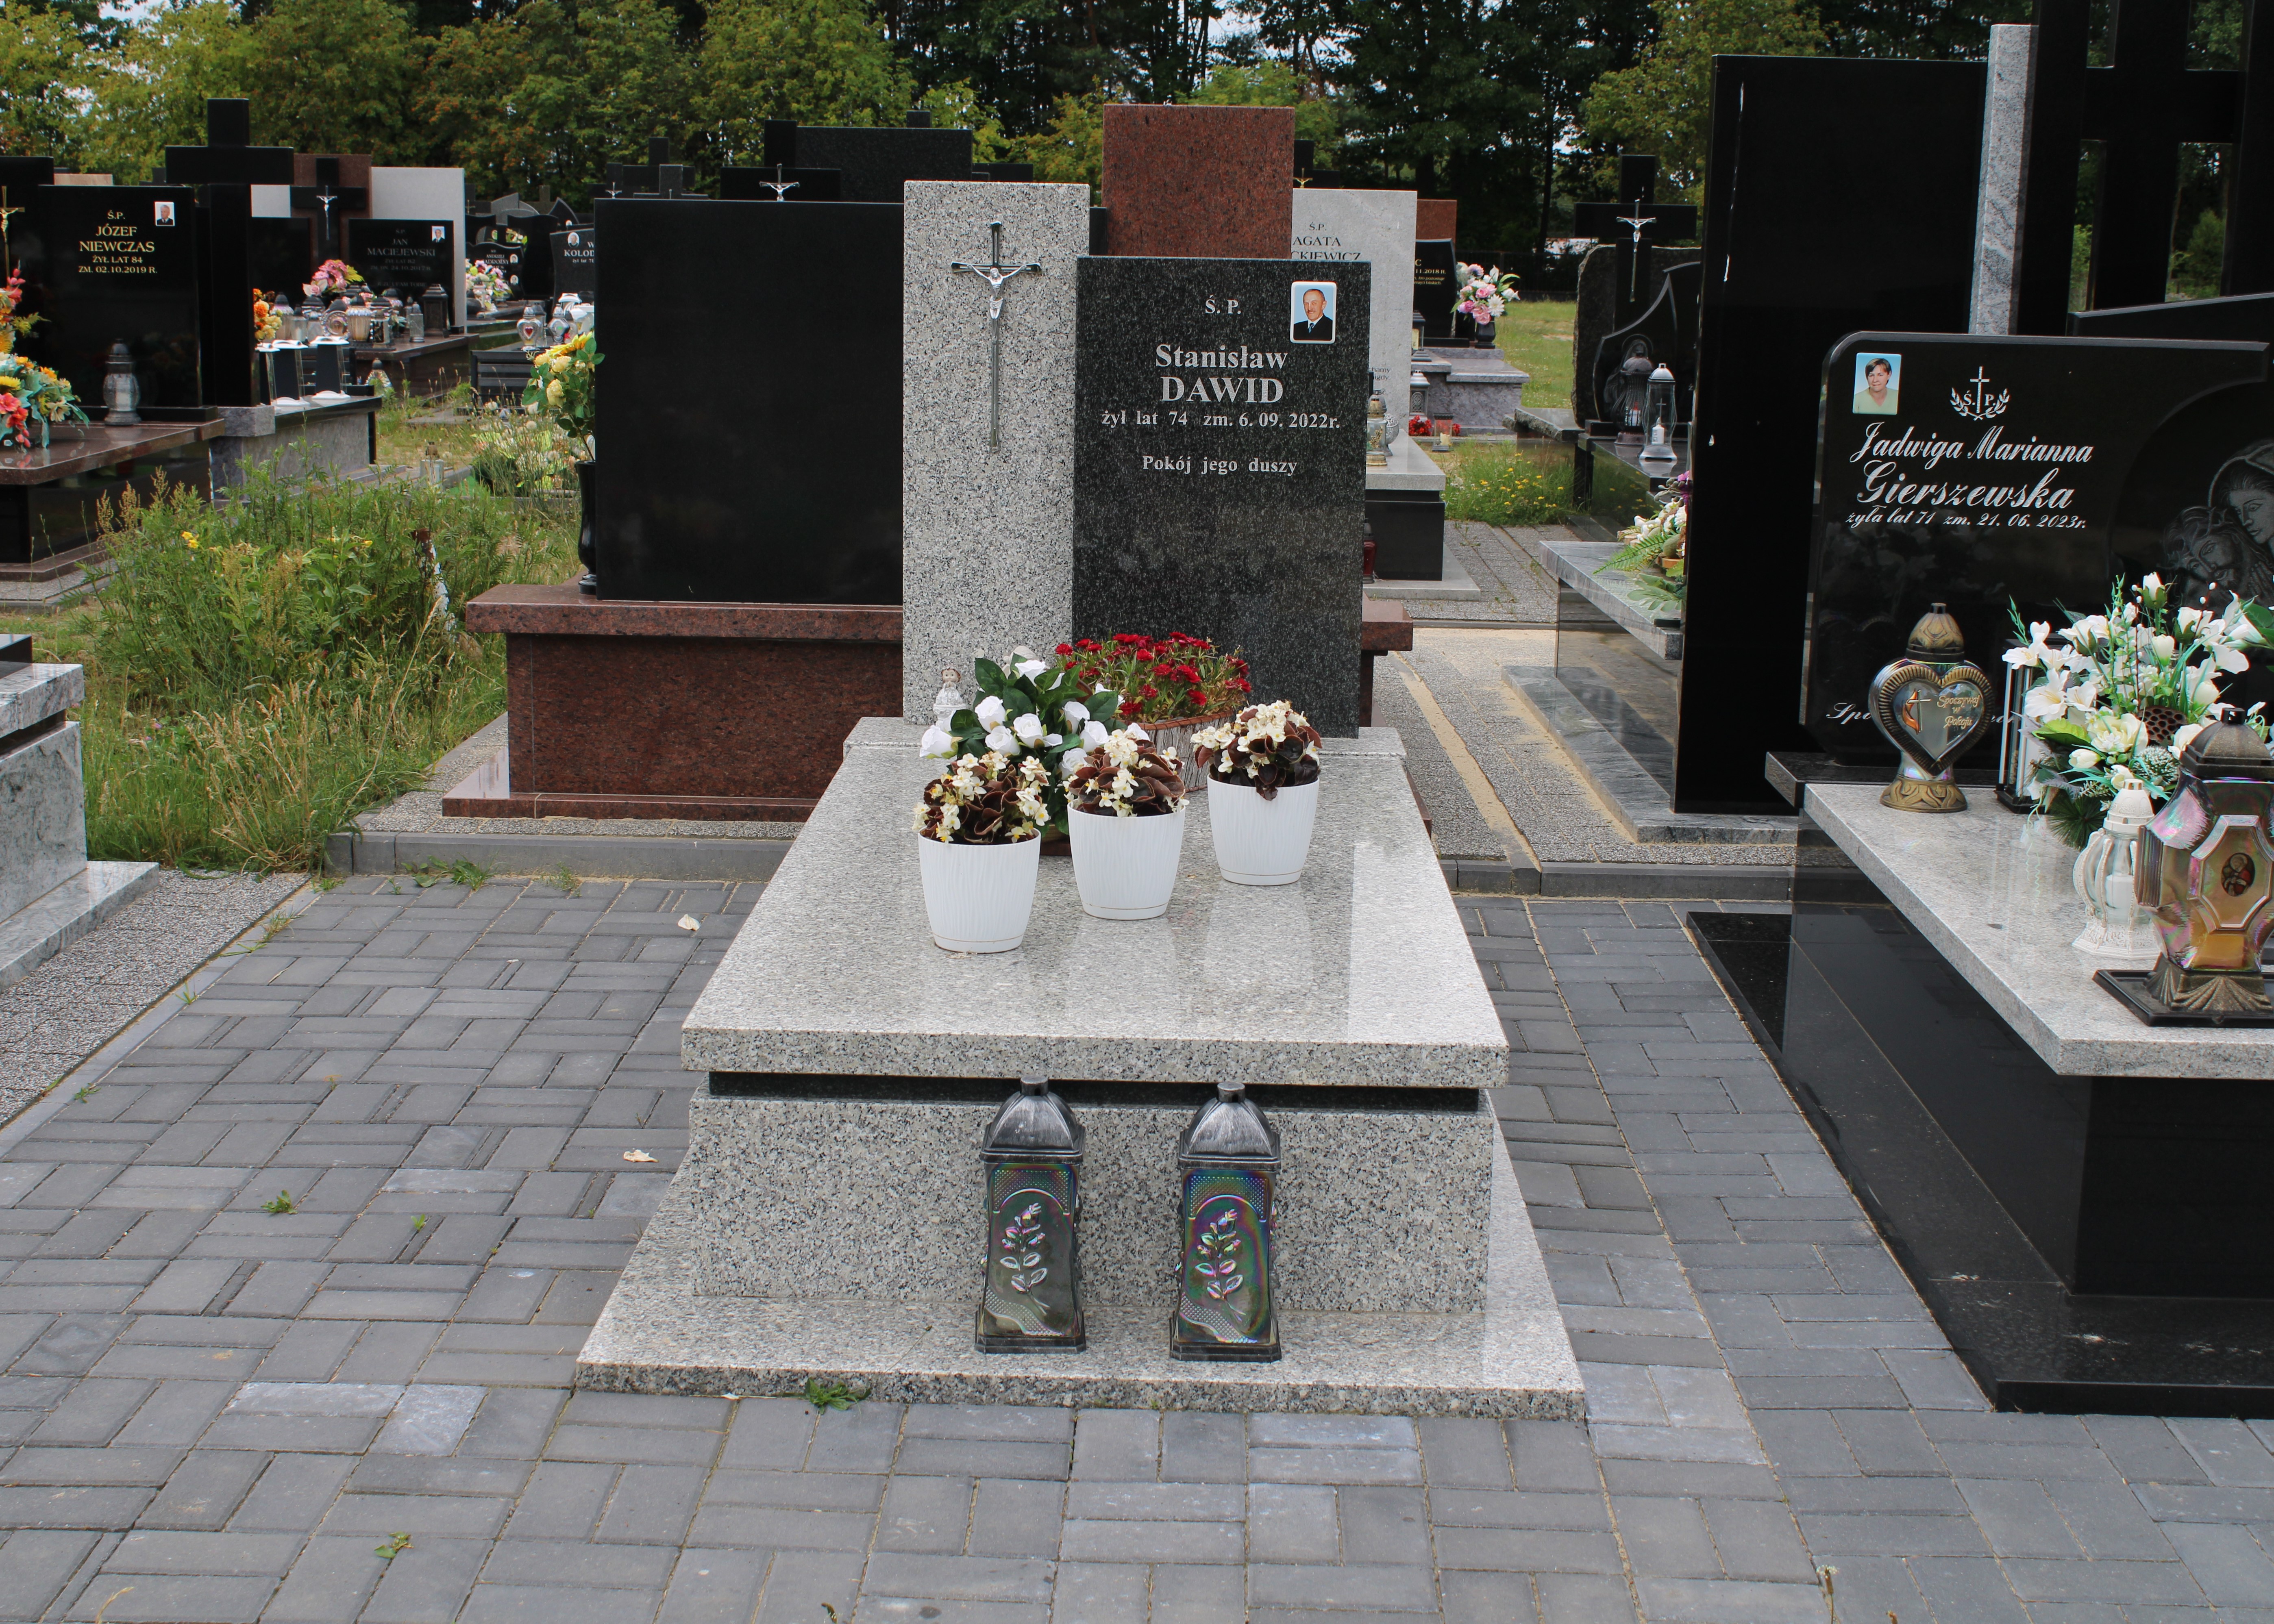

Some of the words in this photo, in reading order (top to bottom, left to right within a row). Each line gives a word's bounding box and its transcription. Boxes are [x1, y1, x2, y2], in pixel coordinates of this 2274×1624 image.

[107, 209, 126, 220] Ś.P.
[96, 223, 137, 237] JÓZEF
[1309, 221, 1327, 231] Ś.P.
[79, 241, 155, 252] NIEWCZAS
[1293, 236, 1341, 246] AGATA
[92, 254, 109, 263] ŻYŁ
[367, 247, 435, 257] MACIEJEWSKI
[1155, 344, 1288, 369] Stanisław
[1161, 376, 1284, 404] DAWID
[1102, 410, 1126, 428] żył
[1136, 410, 1158, 425] lat
[1169, 411, 1188, 426] 74
[1203, 415, 1233, 427] zm.
[1239, 413, 1253, 427] 6.
[1259, 413, 1283, 428] 09.
[1289, 414, 1340, 429] 2022r.
[1849, 422, 1964, 470] Jadwiga
[1967, 425, 2094, 463] Marianna
[1142, 455, 1191, 475] Pokój
[1202, 457, 1238, 475] jego
[1248, 458, 1297, 477] duszy
[1857, 460, 2076, 509] Gierszewska
[1845, 505, 1887, 528] żyła
[1887, 507, 1915, 523] lat
[1915, 511, 1934, 525] 71
[1942, 516, 1971, 526] zm.
[1977, 513, 2000, 527] 21.
[2008, 514, 2030, 527] 06.
[2036, 514, 2087, 529] 2023r.
[1937, 694, 1981, 709] Spoczywaj
[1943, 715, 1974, 729] Pokoju
